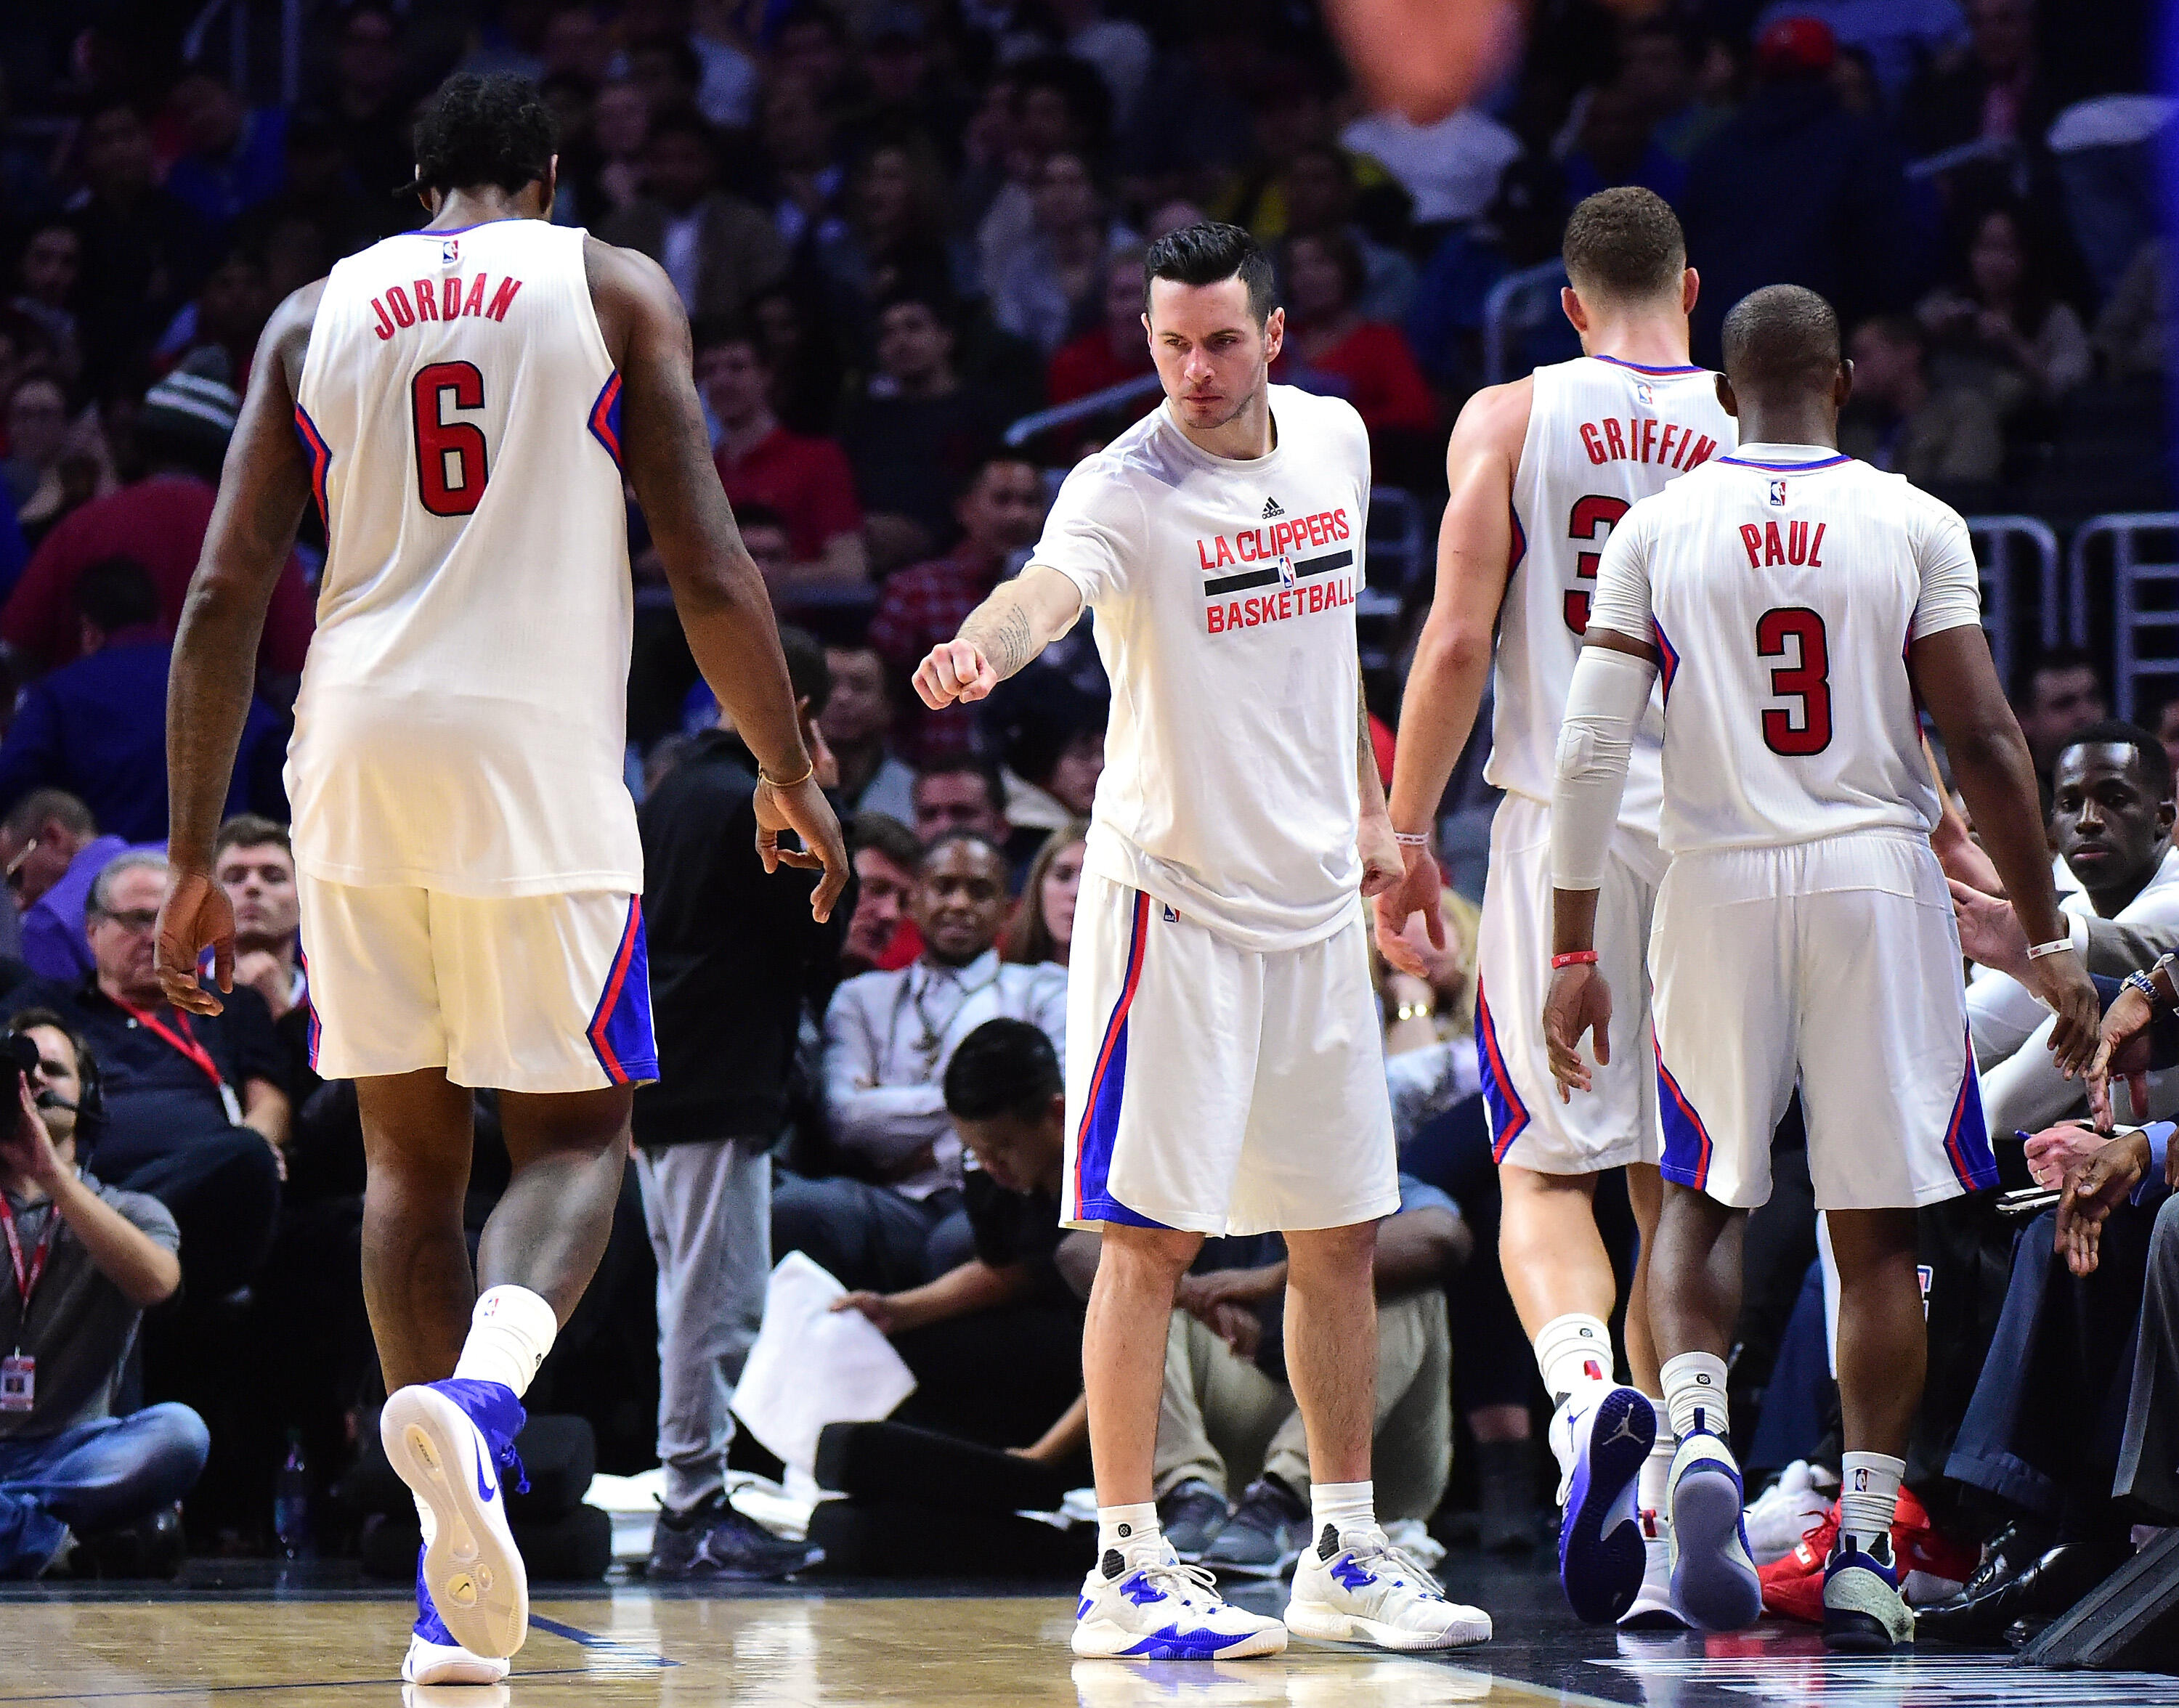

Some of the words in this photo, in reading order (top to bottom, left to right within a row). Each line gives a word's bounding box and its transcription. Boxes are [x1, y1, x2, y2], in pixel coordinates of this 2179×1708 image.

[370, 272, 523, 341] JORDAN
[411, 360, 490, 517] 6
[1580, 418, 1717, 473] GRIFFIN
[1197, 535, 1235, 570] LA
[1236, 508, 1350, 562] CLIPPERS
[1262, 508, 1285, 519] adidas
[1740, 521, 1827, 568] PAUL
[1206, 577, 1355, 634] BASKETBALL
[1756, 607, 1833, 755] 3
